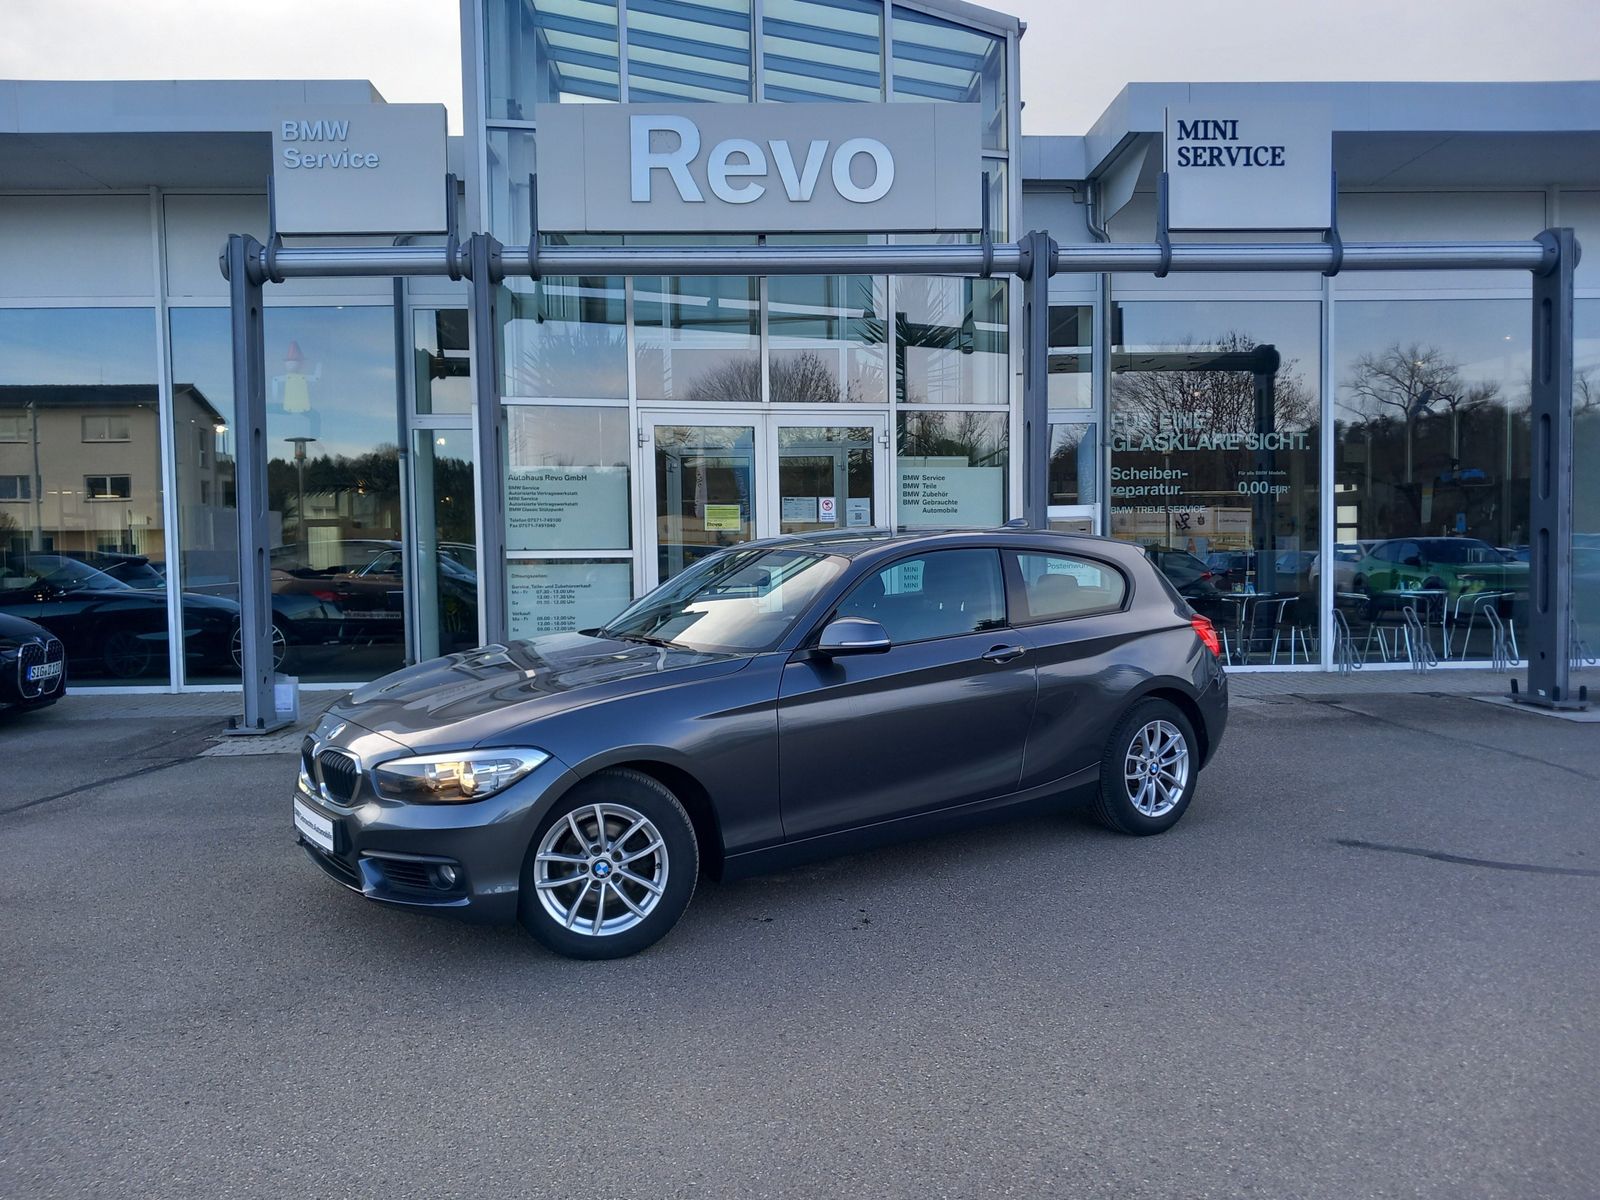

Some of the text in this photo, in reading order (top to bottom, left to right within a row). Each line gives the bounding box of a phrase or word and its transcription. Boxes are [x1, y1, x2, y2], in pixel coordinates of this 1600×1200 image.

[281, 119, 350, 142] BMW
[1177, 119, 1239, 141] MINI
[283, 147, 380, 169] Service
[628, 114, 896, 204] Revo
[1177, 146, 1286, 167] SERVICE
[1160, 411, 1207, 429] EINE
[1111, 432, 1311, 452] GLASKLARE SICHT.
[1111, 467, 1189, 481] Scheiben-
[1111, 484, 1184, 498] reparatur.
[1238, 481, 1268, 496] 0,00
[1111, 507, 1133, 515] BMW
[1135, 506, 1166, 514] TREUE
